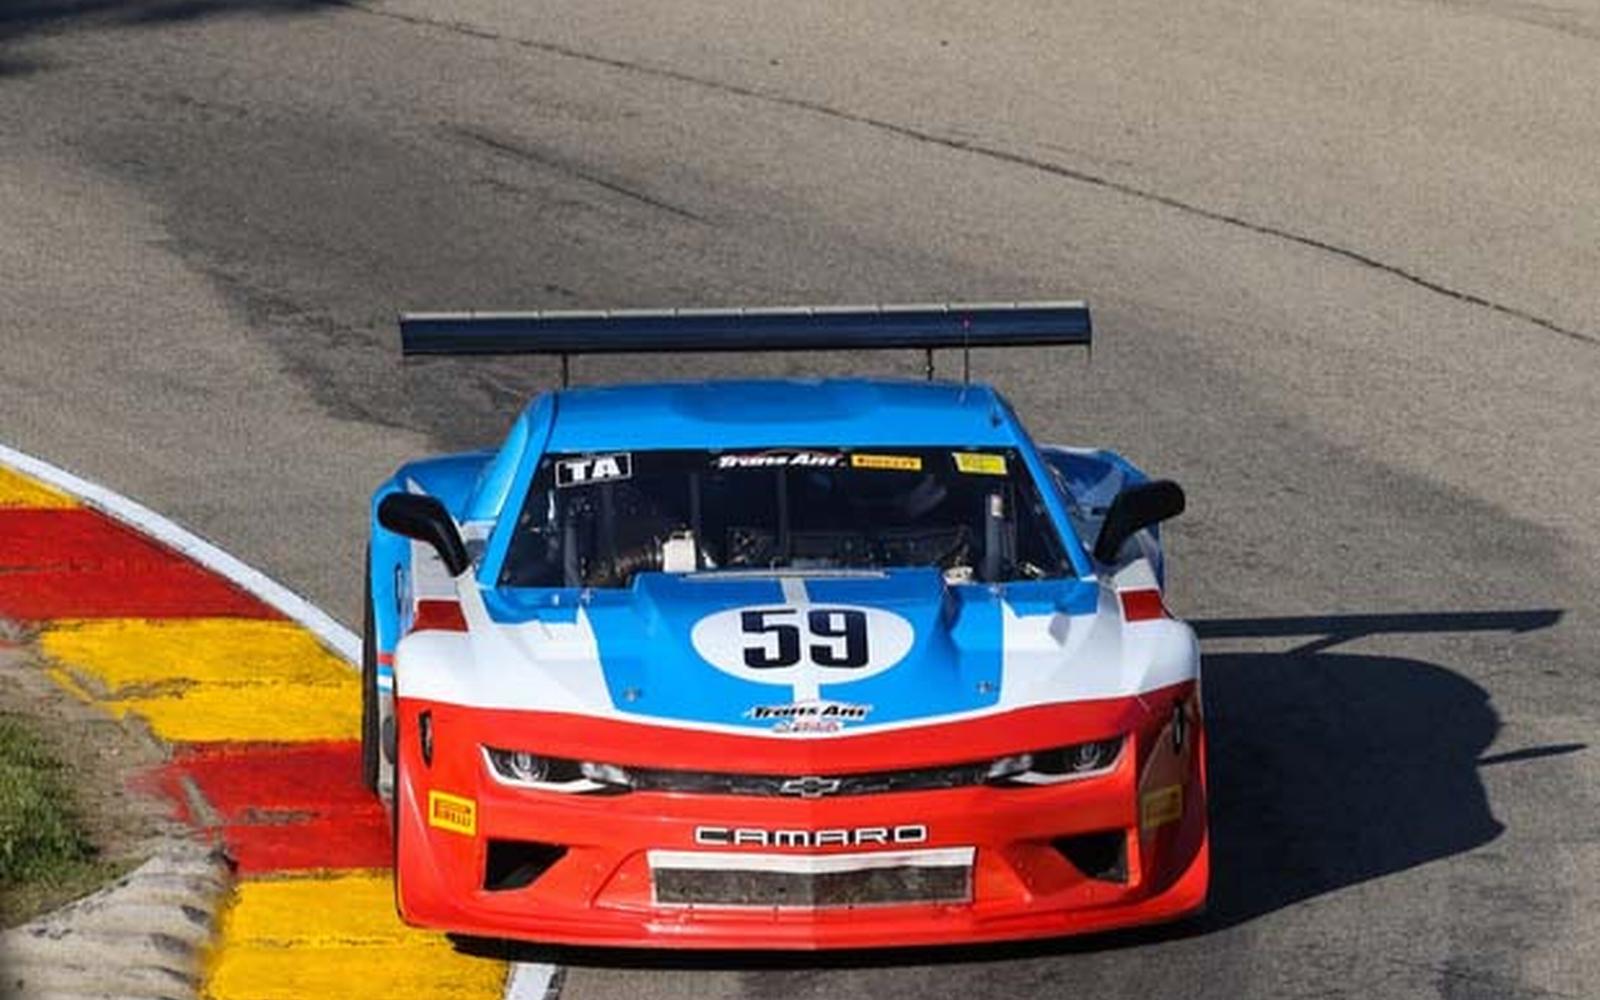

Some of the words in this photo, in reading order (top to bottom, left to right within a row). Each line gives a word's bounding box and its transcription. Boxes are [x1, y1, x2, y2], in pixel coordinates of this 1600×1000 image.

[565, 457, 621, 480] TA
[741, 609, 869, 669] 59
[695, 825, 927, 847] CAMARO
